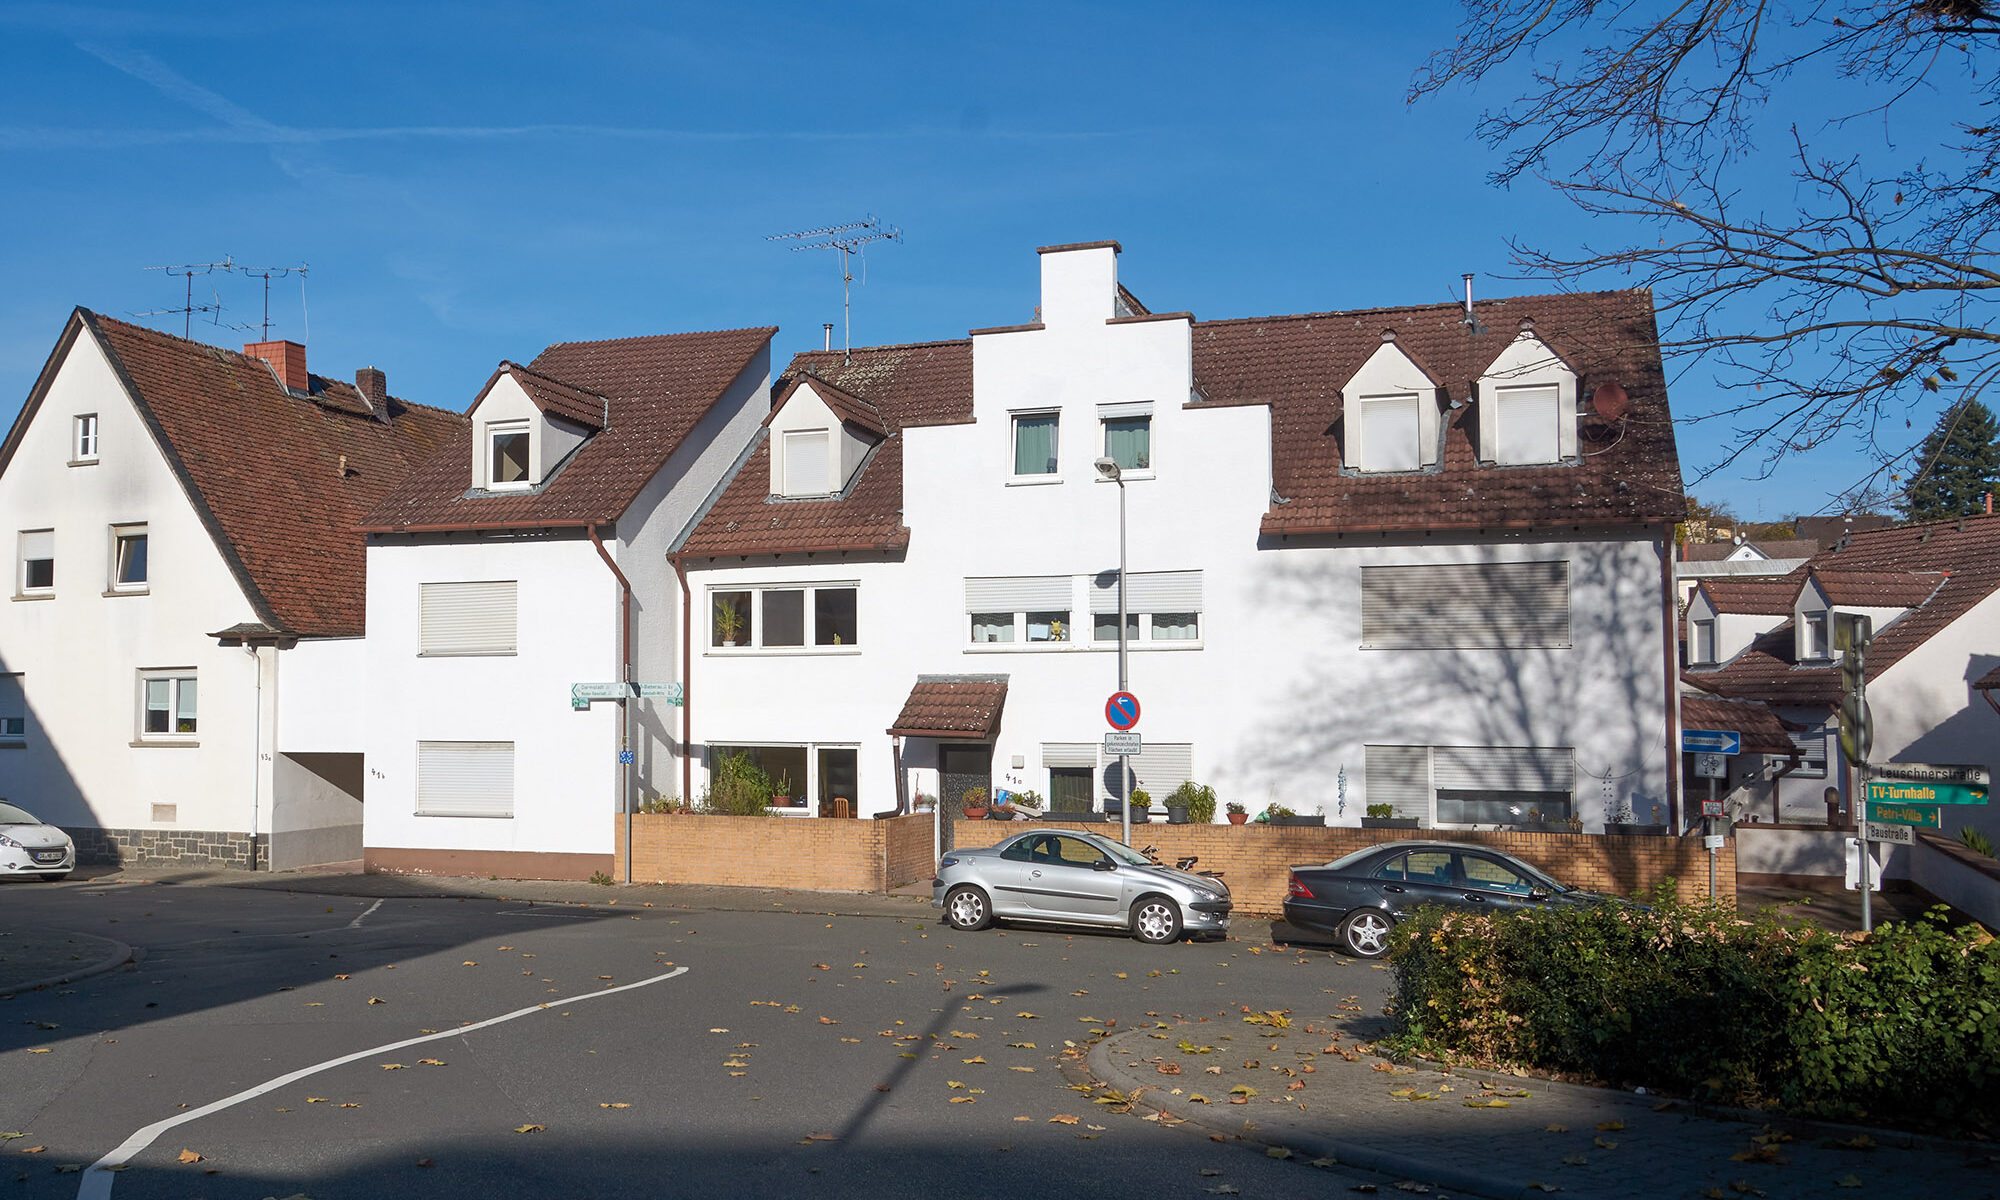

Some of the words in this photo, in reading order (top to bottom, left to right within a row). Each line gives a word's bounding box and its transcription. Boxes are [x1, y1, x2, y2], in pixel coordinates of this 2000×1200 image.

[1880, 767, 1981, 780] Leuschnerstraße
[1871, 786, 1935, 799] TV-Turnhalle
[1876, 806, 1922, 822] Petri-Villa
